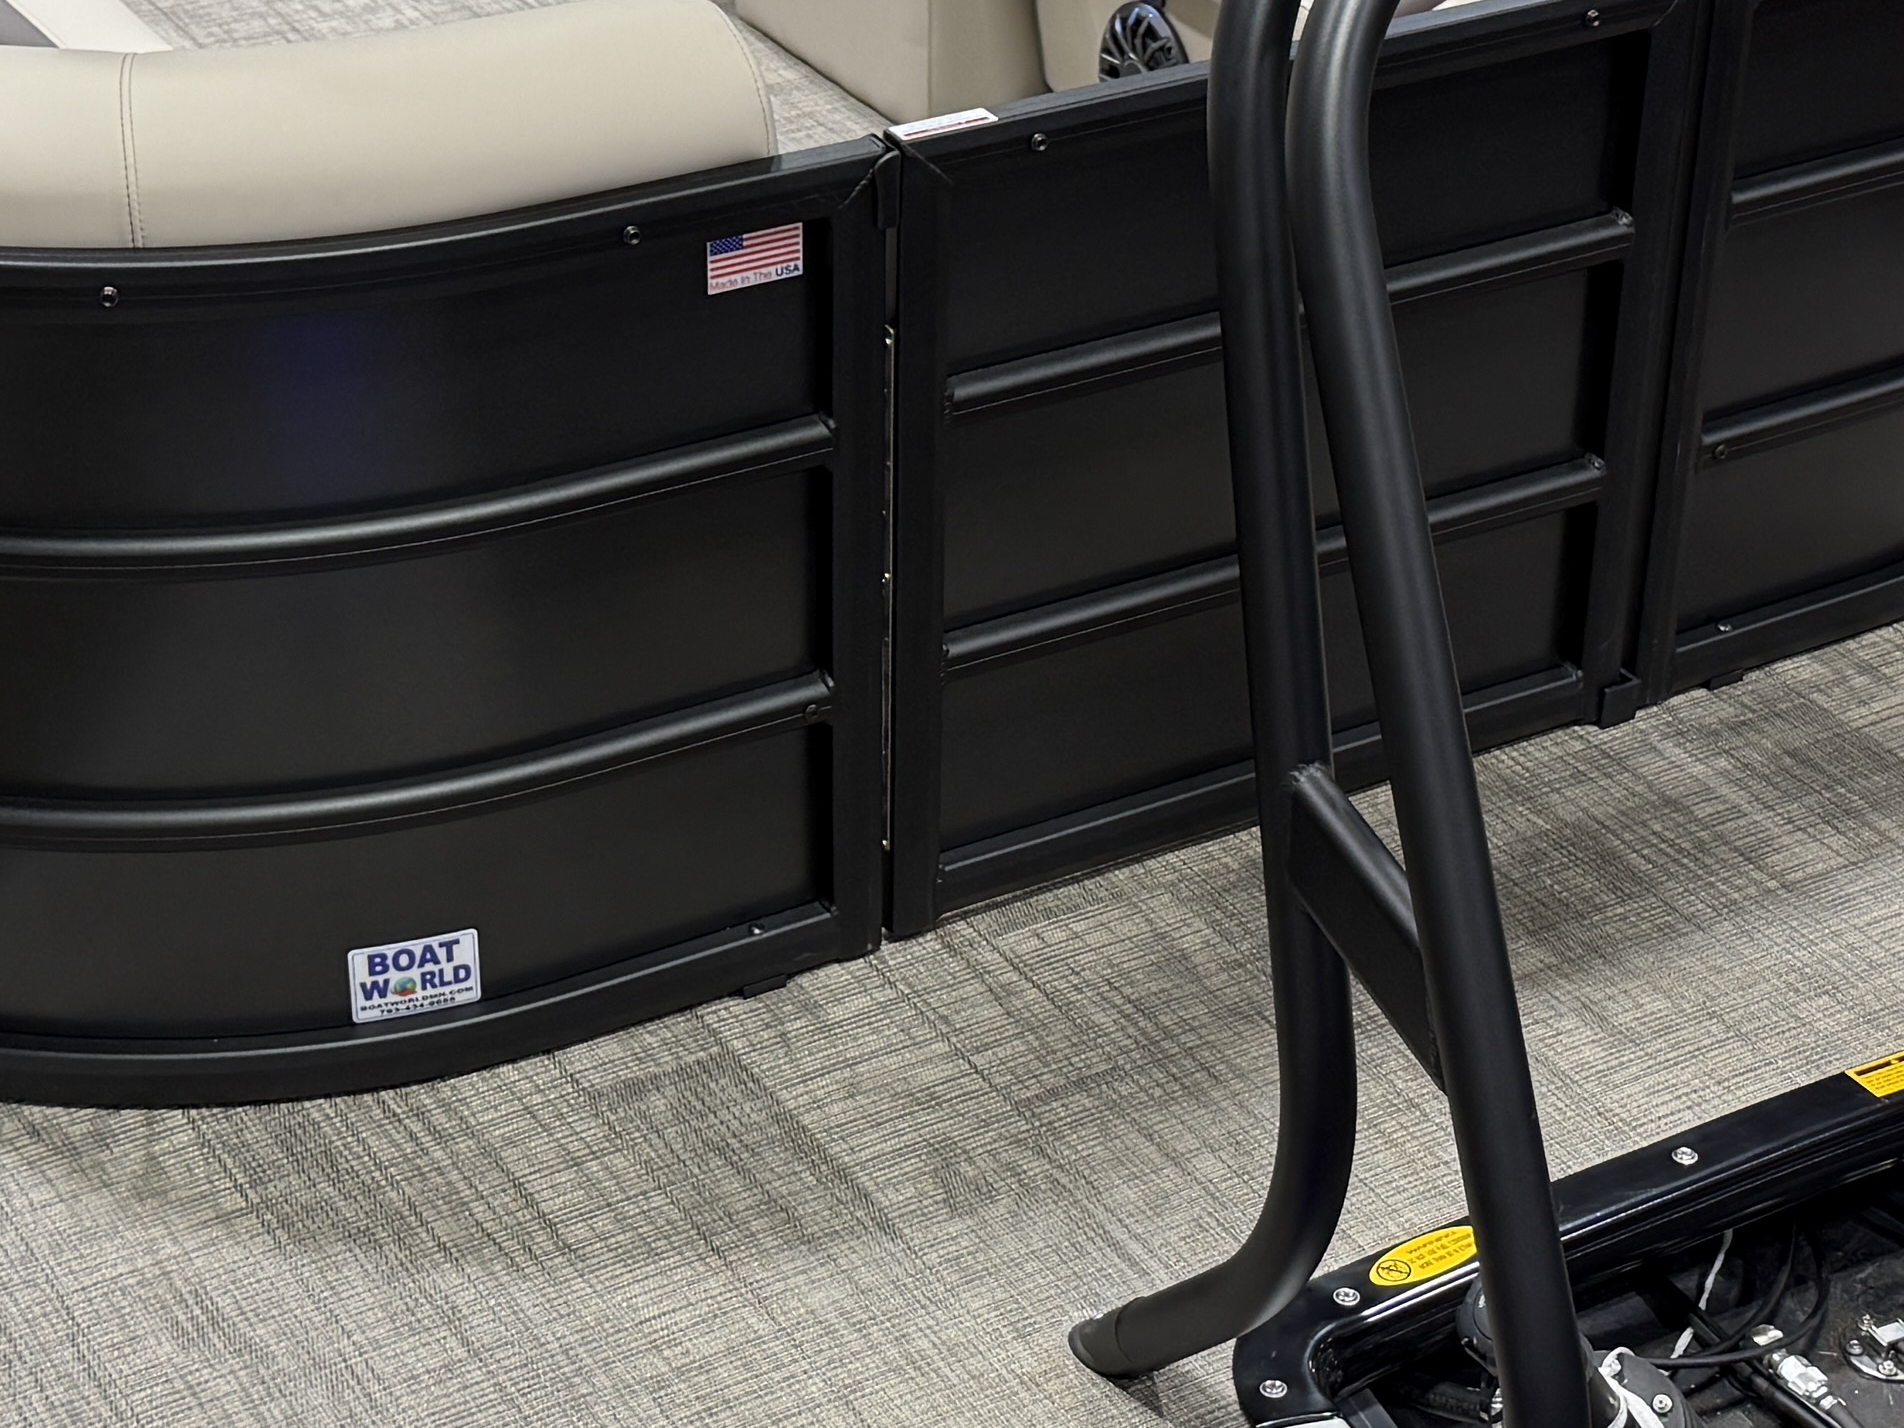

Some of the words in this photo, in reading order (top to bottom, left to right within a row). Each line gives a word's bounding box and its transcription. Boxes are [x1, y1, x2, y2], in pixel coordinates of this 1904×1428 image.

[710, 278, 738, 291] Made
[752, 271, 772, 282] The
[775, 263, 800, 277] USA
[367, 938, 460, 977] BOAT
[360, 985, 474, 1012] BOATWORLDMN.COM
